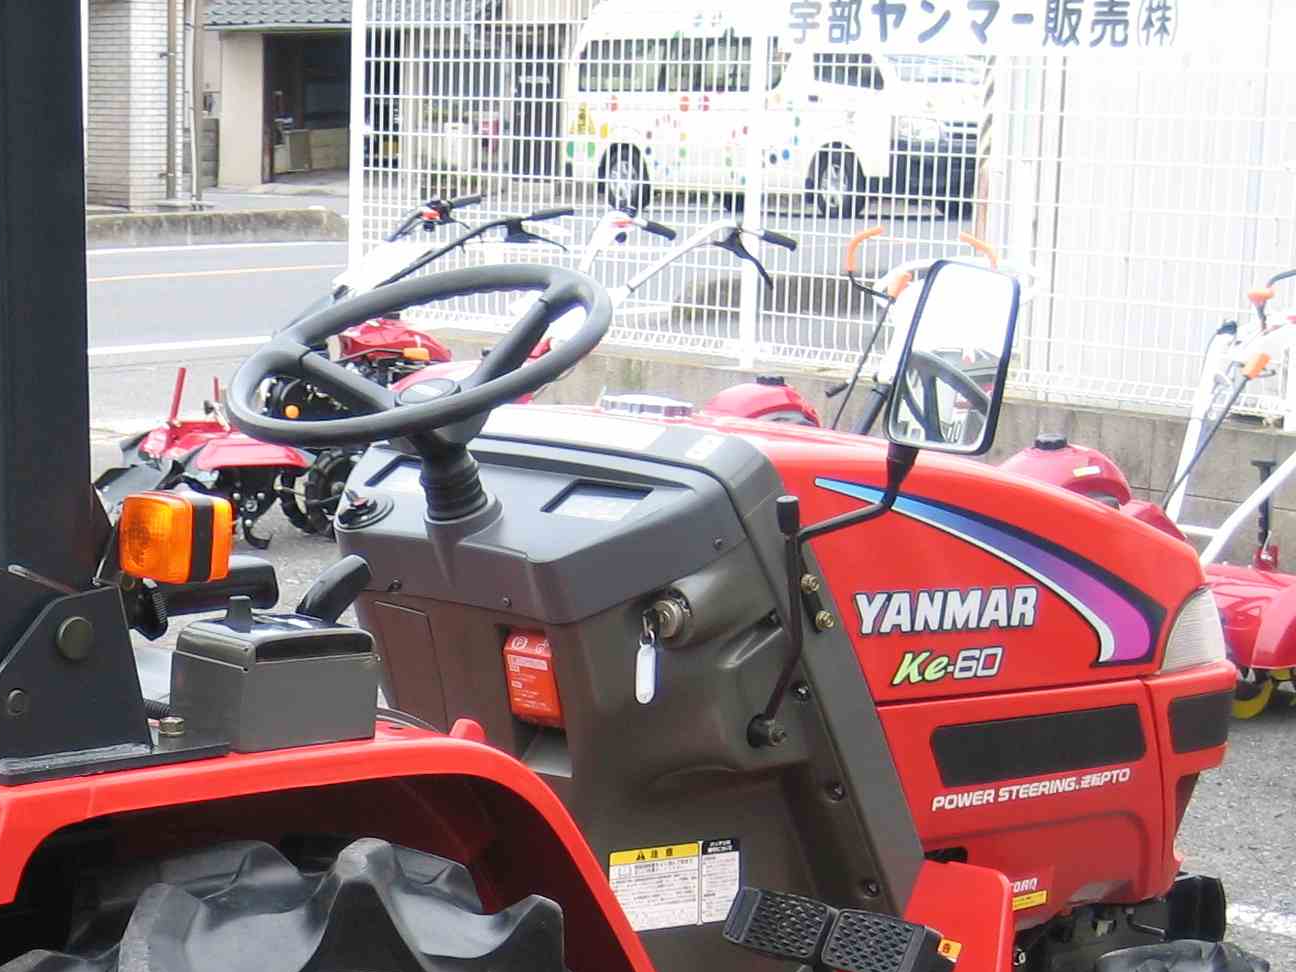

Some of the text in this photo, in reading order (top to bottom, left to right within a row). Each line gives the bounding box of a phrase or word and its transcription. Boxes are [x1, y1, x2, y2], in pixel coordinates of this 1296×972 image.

[855, 587, 1037, 634] YANMAR
[892, 647, 1003, 685] Ke-60
[932, 789, 995, 811] POWER
